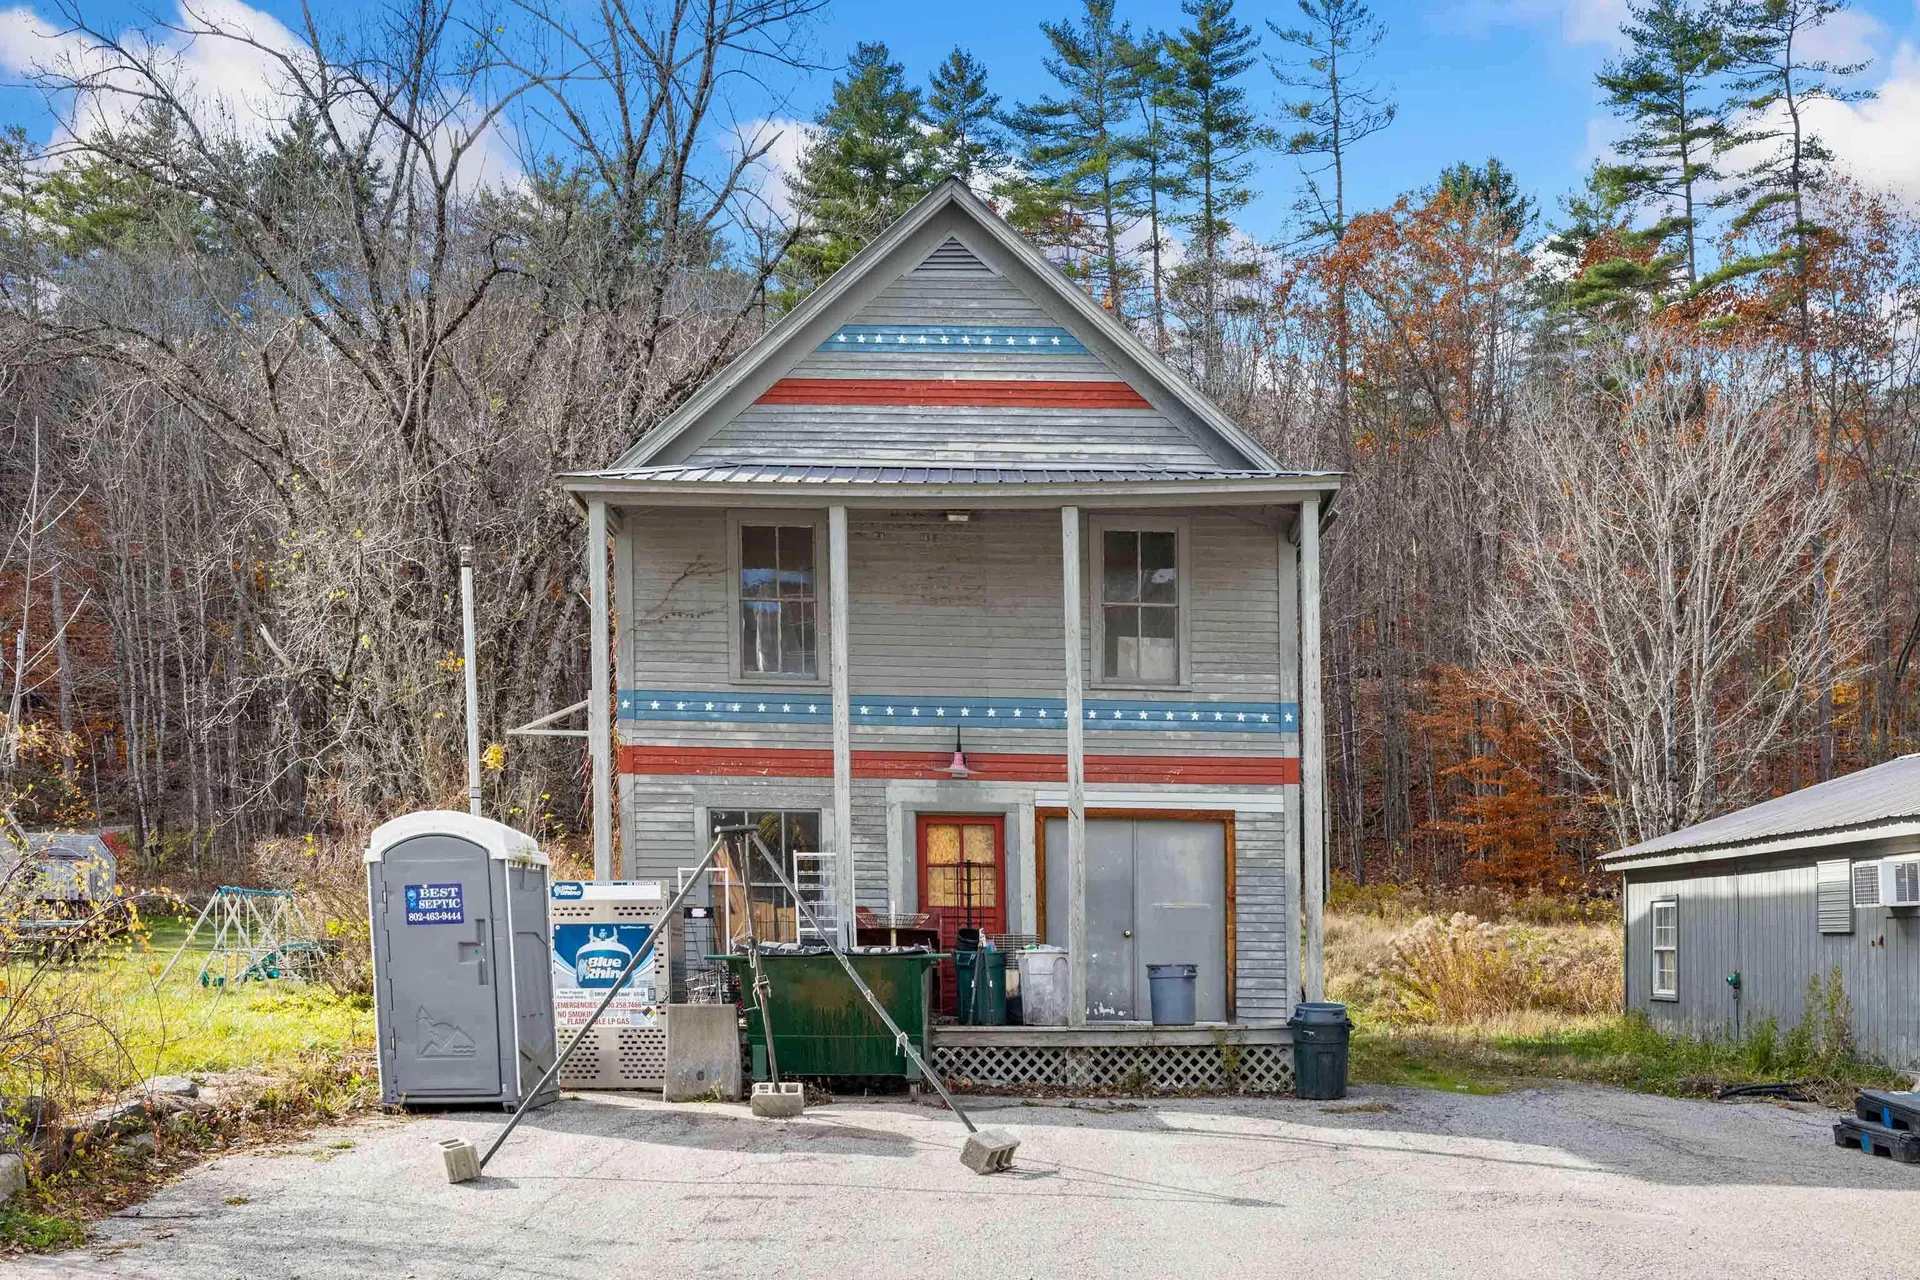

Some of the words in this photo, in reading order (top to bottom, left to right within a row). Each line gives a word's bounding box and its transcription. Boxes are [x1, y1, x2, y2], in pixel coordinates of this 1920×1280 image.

[419, 887, 459, 898] BEST
[418, 898, 461, 909] SEPTIC
[589, 956, 622, 968] Blue
[557, 1001, 598, 1009] EMERGENCIES:
[557, 1010, 567, 1018] NO
